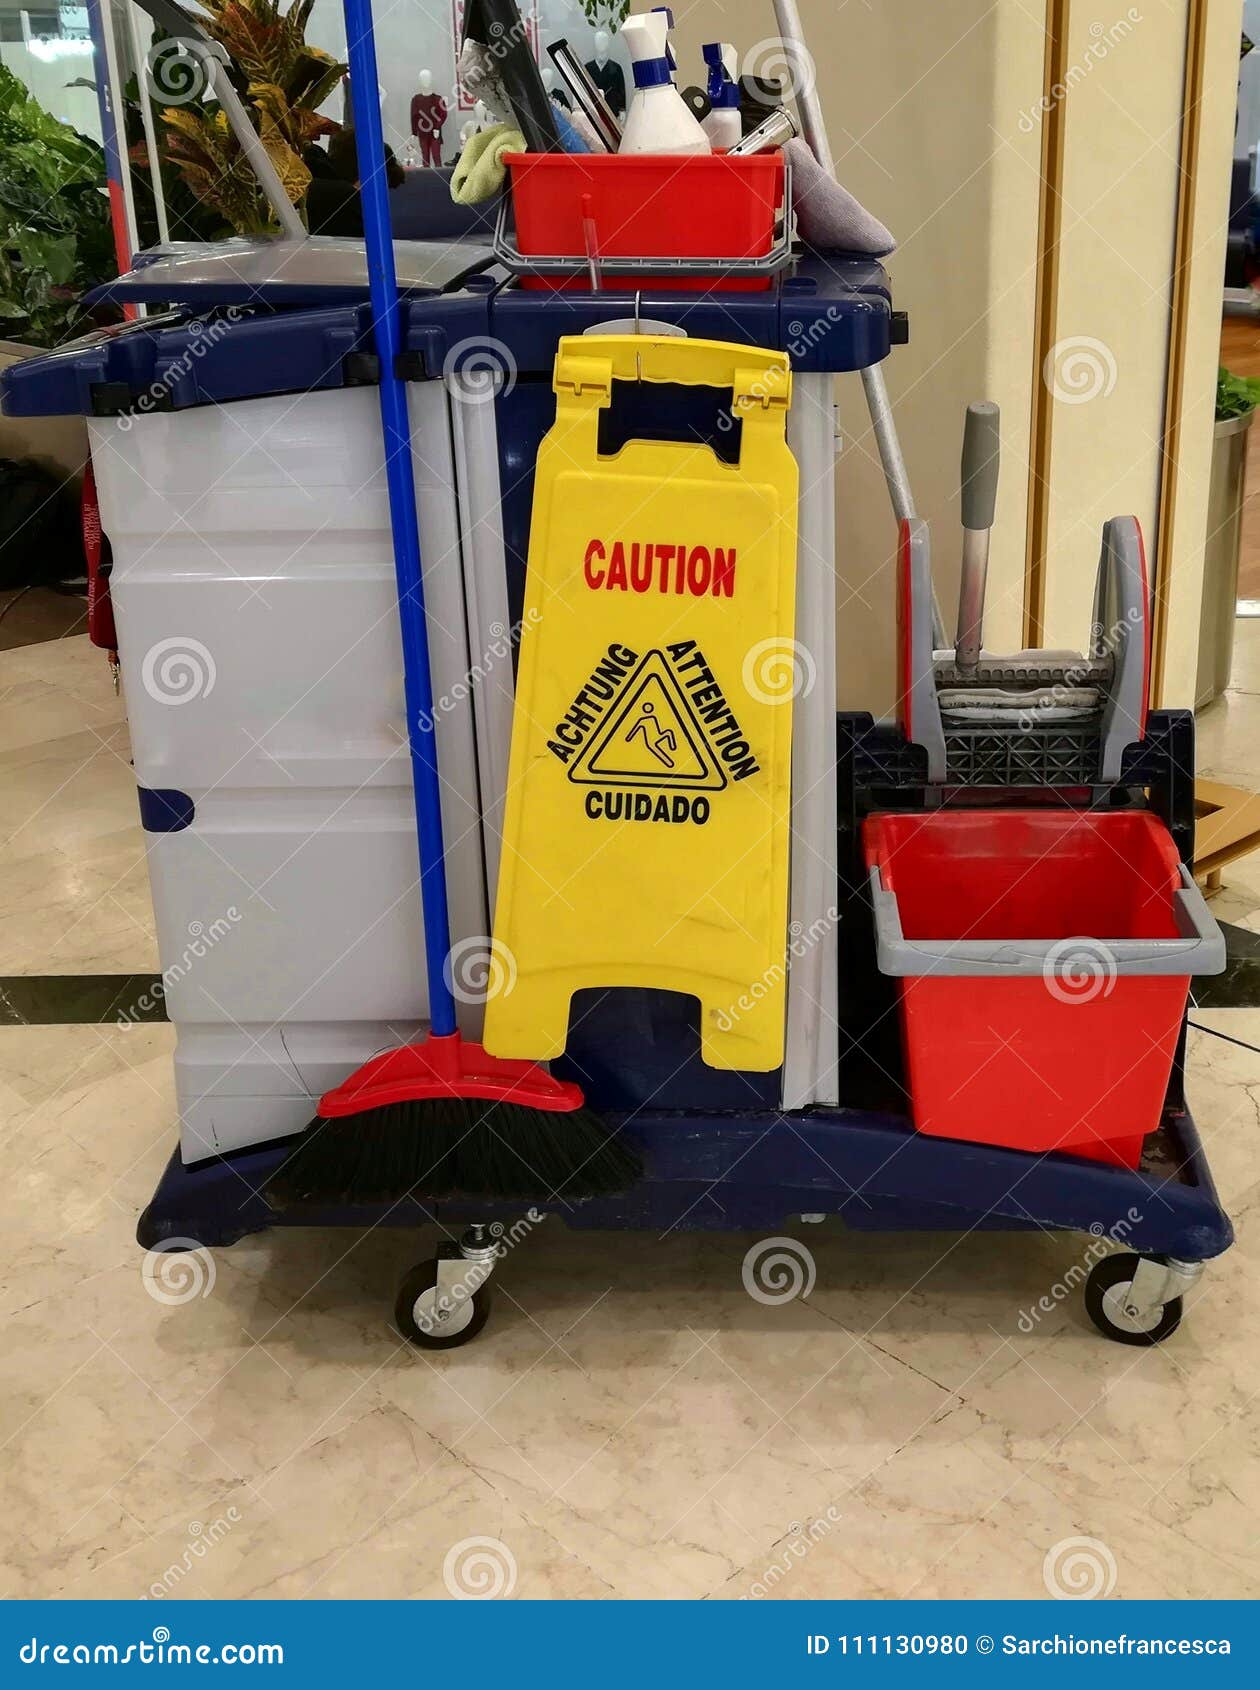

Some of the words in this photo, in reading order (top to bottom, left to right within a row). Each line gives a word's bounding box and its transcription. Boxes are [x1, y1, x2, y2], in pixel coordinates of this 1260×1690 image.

[584, 539, 737, 598] CAUTION
[546, 643, 639, 764] ACHTUNG
[666, 640, 760, 781] ATTENTION
[585, 791, 710, 825] CUIDADO
